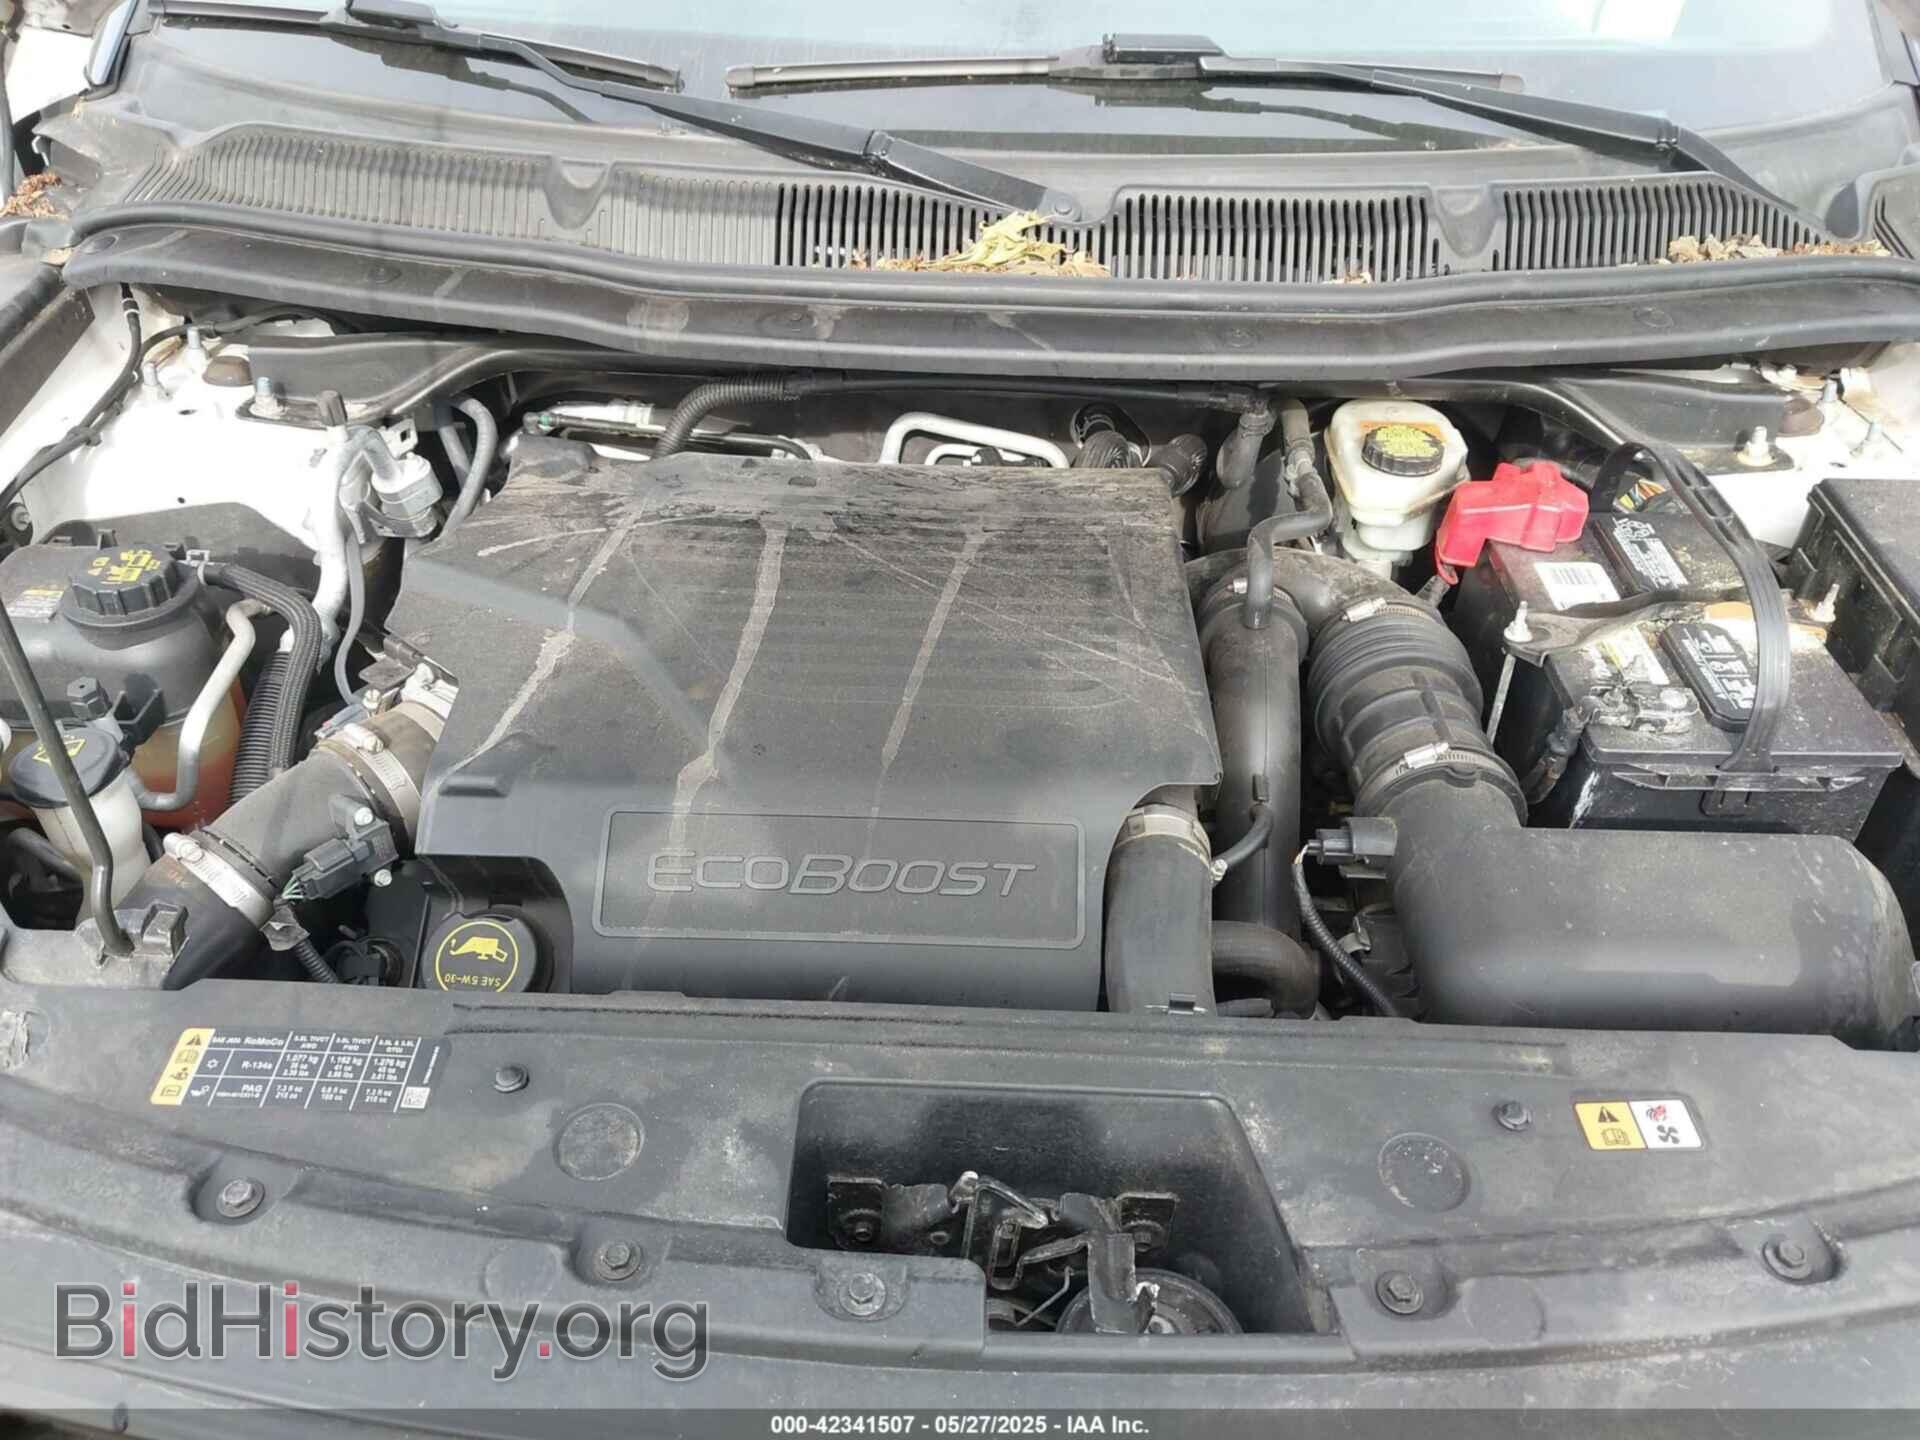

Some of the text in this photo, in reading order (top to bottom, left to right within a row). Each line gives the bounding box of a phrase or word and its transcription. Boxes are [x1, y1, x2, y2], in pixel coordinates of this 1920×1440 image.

[444, 973, 502, 987] SAE 5W-30
[241, 1083, 263, 1093] PAG
